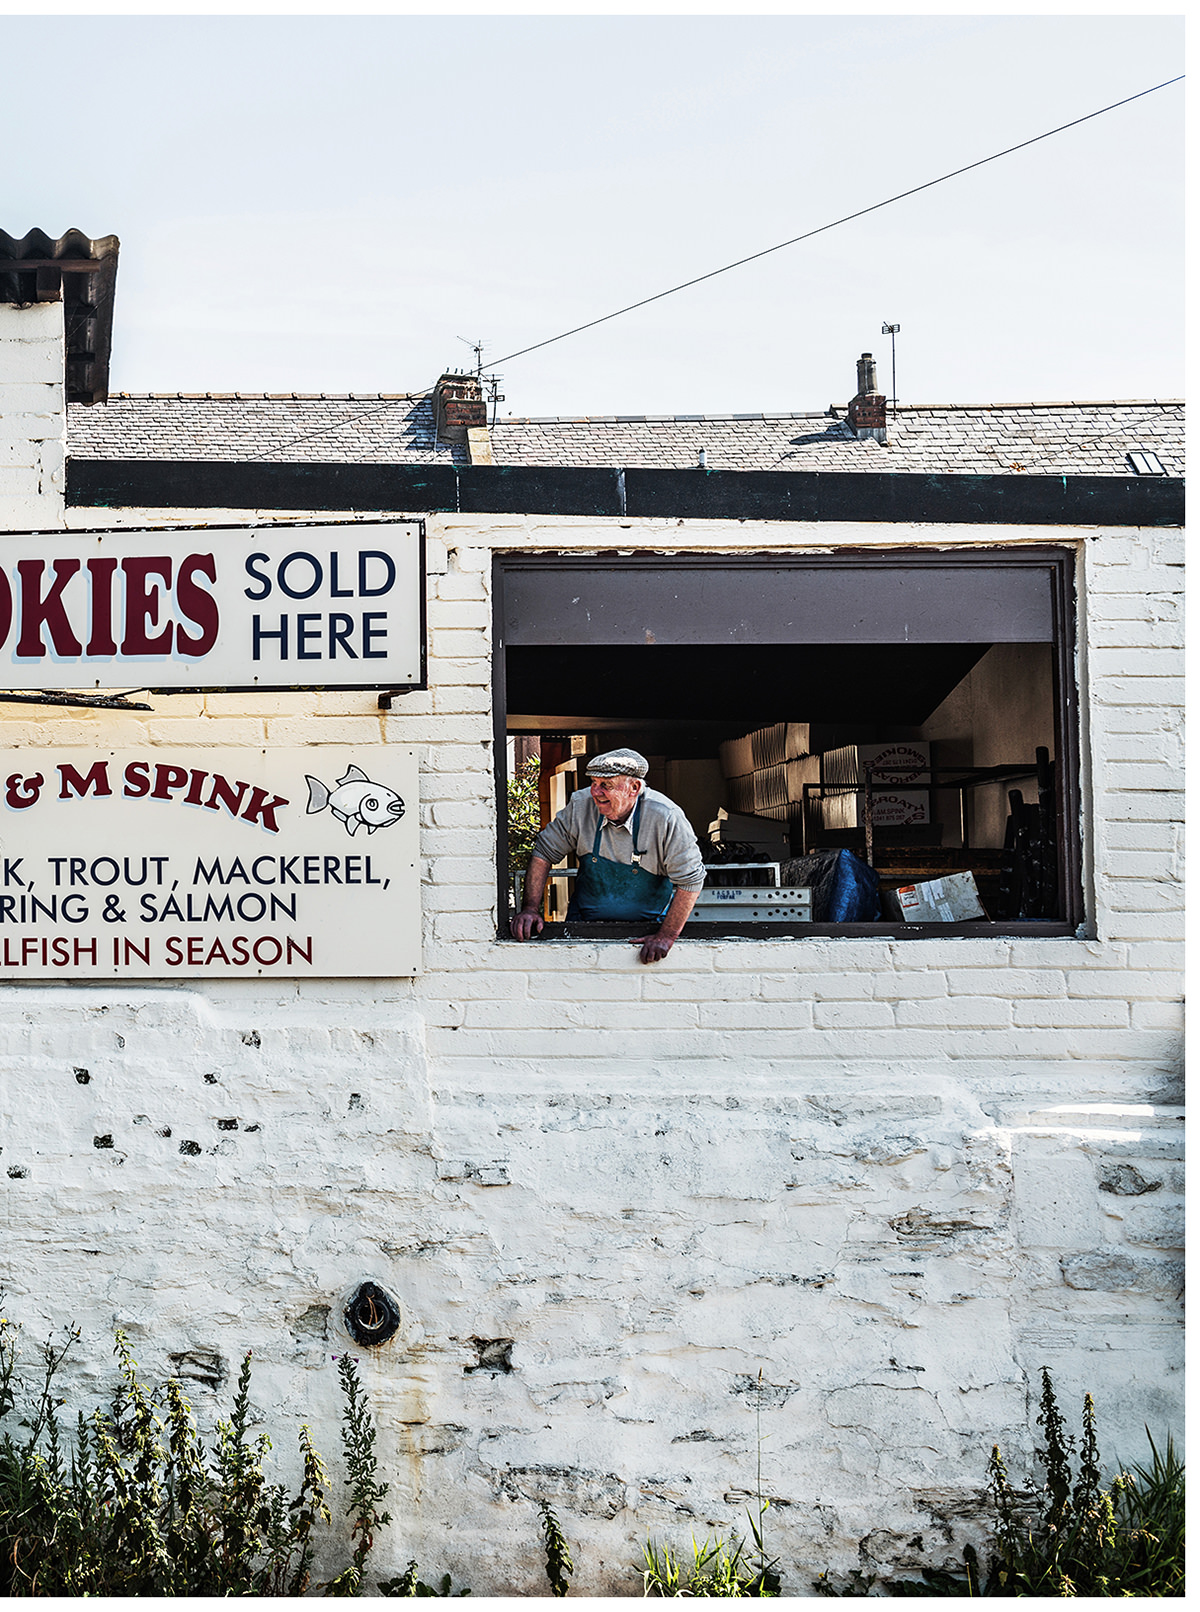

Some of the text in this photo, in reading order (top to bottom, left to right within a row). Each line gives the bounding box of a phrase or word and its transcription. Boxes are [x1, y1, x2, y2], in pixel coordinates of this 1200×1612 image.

[244, 550, 397, 601] SOLD
[252, 611, 389, 661] HERE
[4, 771, 45, 811] &
[56, 760, 114, 799] M
[123, 761, 291, 834] SPINK
[47, 856, 180, 892] TROUT,
[192, 855, 391, 891] MACKEREL,
[101, 893, 128, 923] &
[139, 892, 298, 923] SALMON
[112, 936, 151, 967] IN
[164, 935, 313, 967] SEASON
